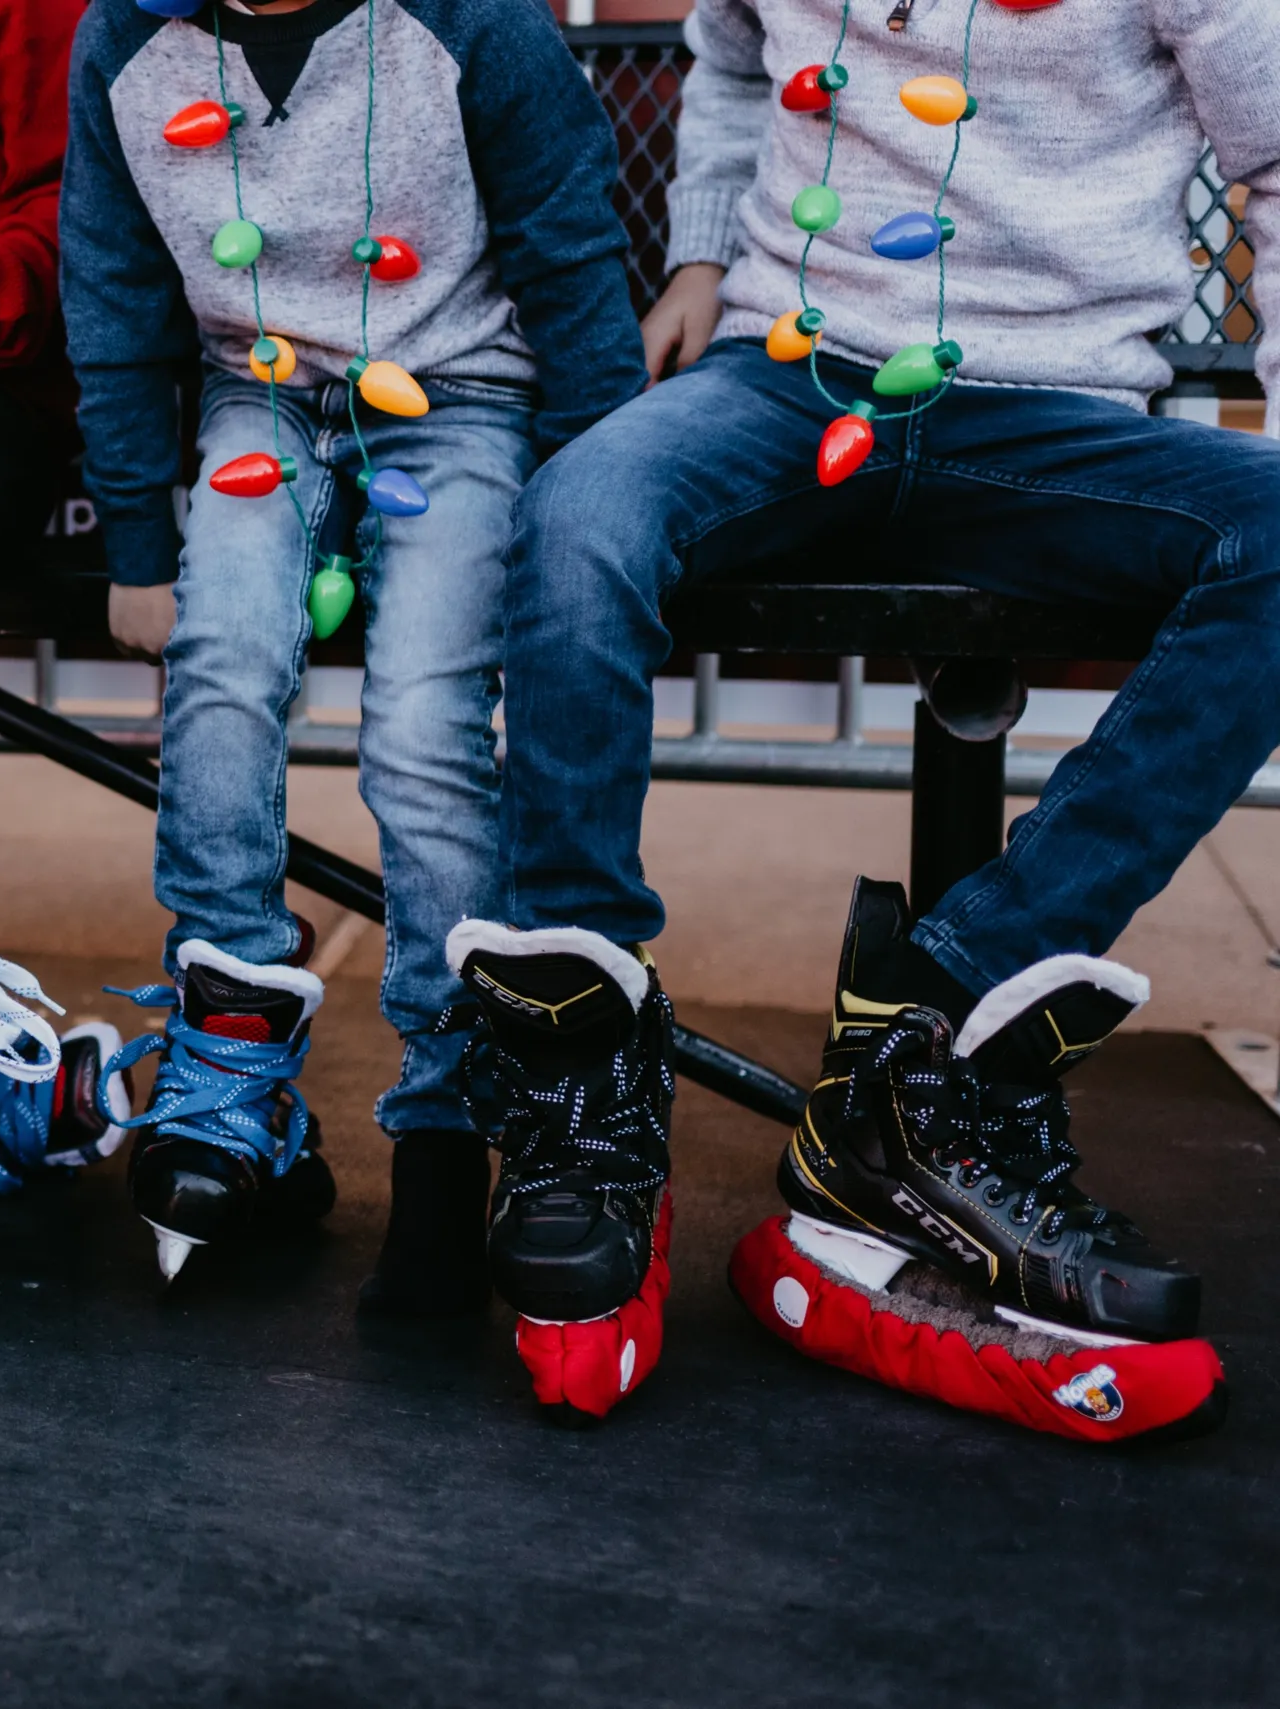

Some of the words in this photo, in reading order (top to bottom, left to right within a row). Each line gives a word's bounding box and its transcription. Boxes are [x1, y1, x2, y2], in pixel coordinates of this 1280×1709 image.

[472, 971, 544, 1016] CCM
[891, 1188, 981, 1264] CCM
[1051, 1363, 1117, 1408] HOWIES
